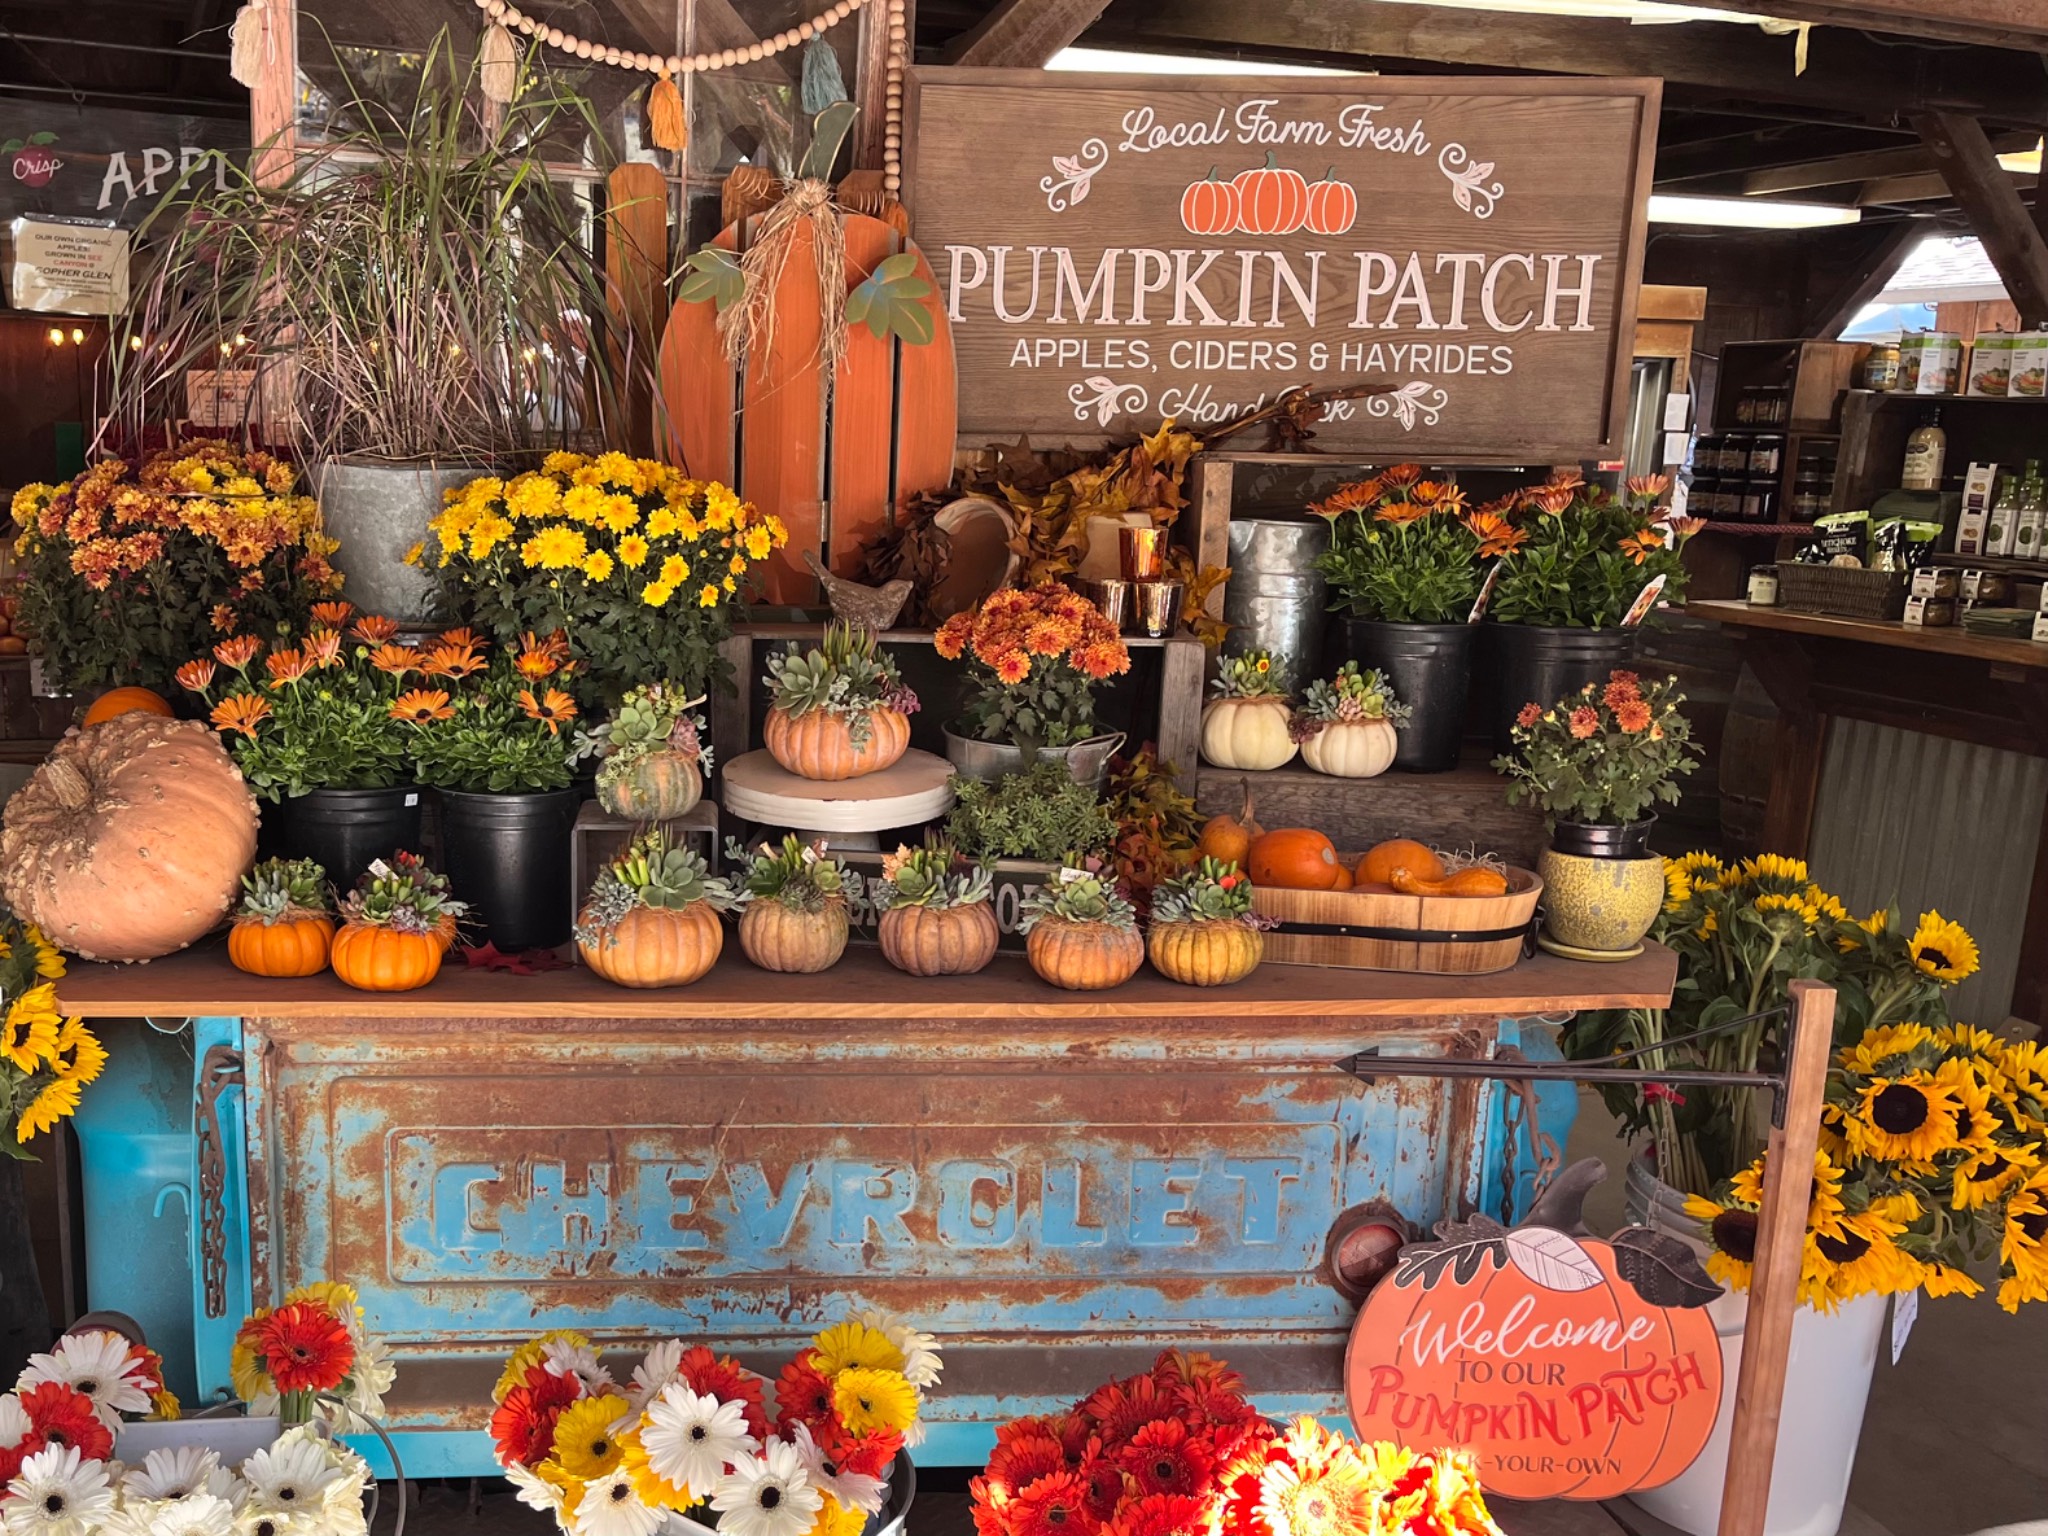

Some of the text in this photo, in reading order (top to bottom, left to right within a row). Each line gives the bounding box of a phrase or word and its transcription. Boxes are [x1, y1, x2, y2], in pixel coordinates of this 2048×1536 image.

[1119, 99, 1431, 156] Local Farm Fresh
[13, 153, 64, 180] Crisp
[97, 147, 246, 211] APPL
[45, 251, 76, 259] GROWN
[53, 259, 88, 268] CANYON
[82, 270, 112, 279] GLEN
[944, 245, 1602, 333] PUMPKIN PATCH
[1009, 338, 1513, 375] APPLES, CIDERS & HAYRIDES
[433, 1157, 1303, 1251] CHEVROLET
[1399, 1294, 1656, 1367] Welcome
[1456, 1361, 1566, 1387] TO OUR
[1364, 1351, 1709, 1446] PUMPKIN PATCH
